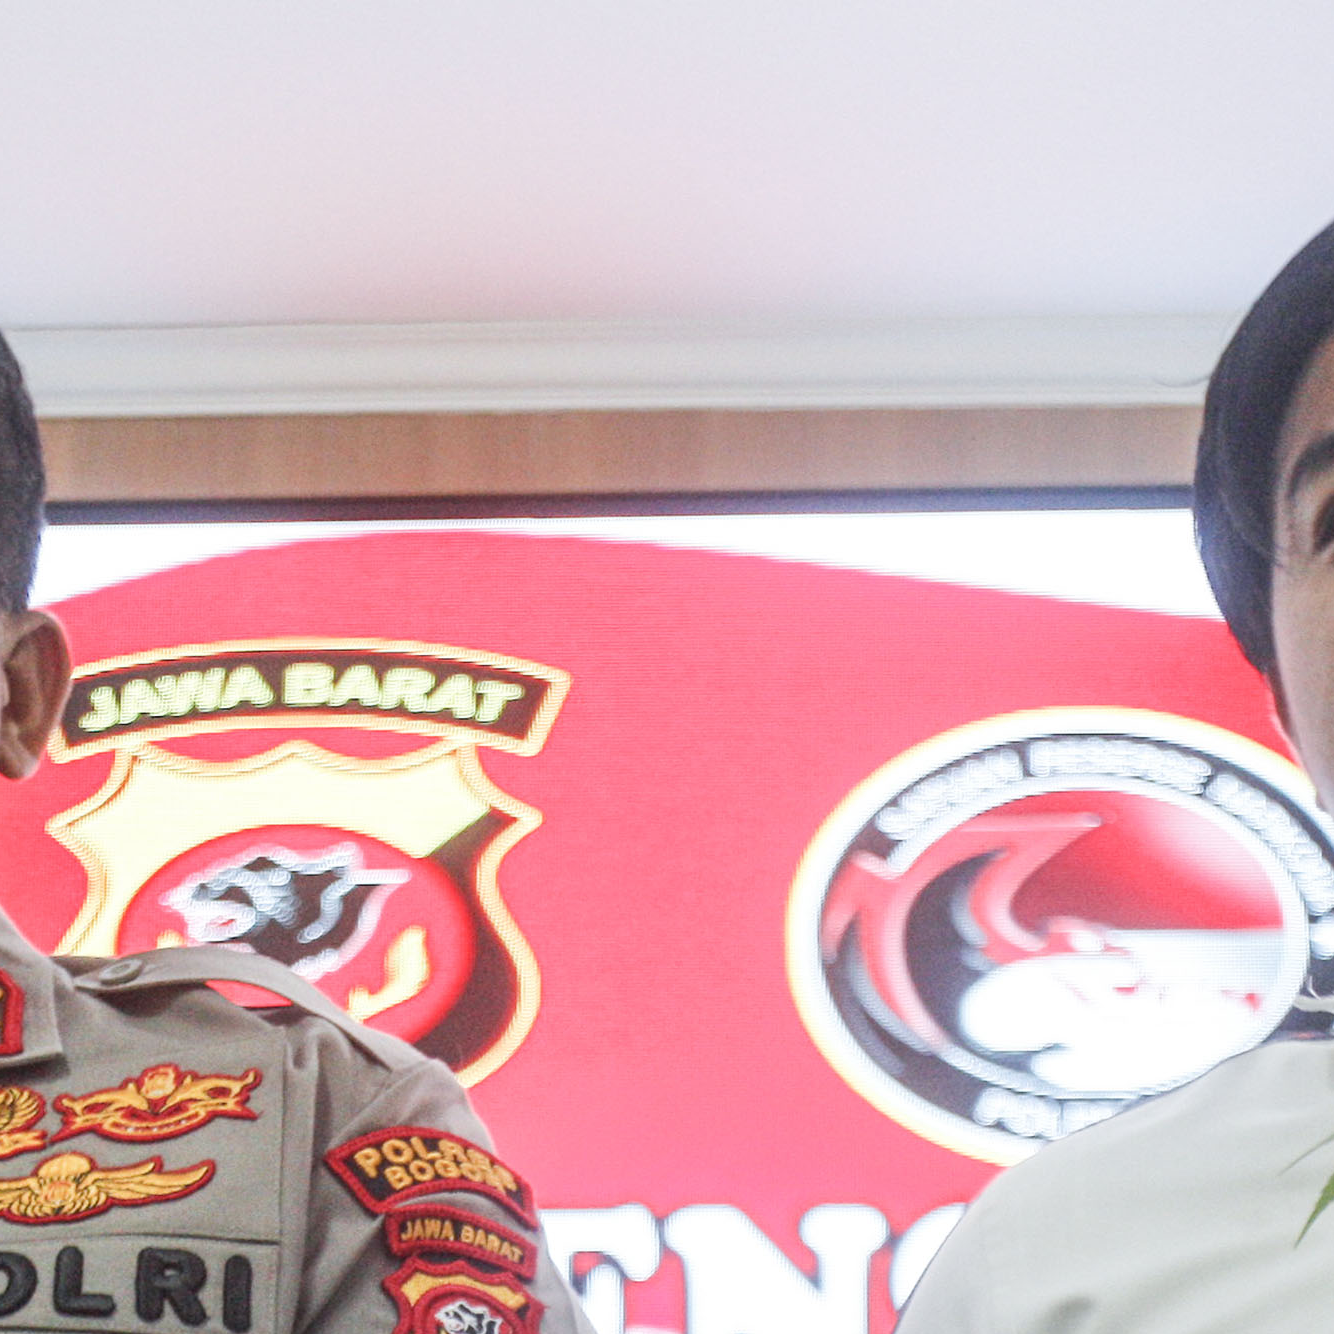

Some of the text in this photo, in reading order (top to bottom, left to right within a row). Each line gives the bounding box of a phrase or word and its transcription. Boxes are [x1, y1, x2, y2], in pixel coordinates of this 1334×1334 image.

[79, 662, 525, 732] JAWA BARAT
[400, 1217, 524, 1264] JAWA BARAT
